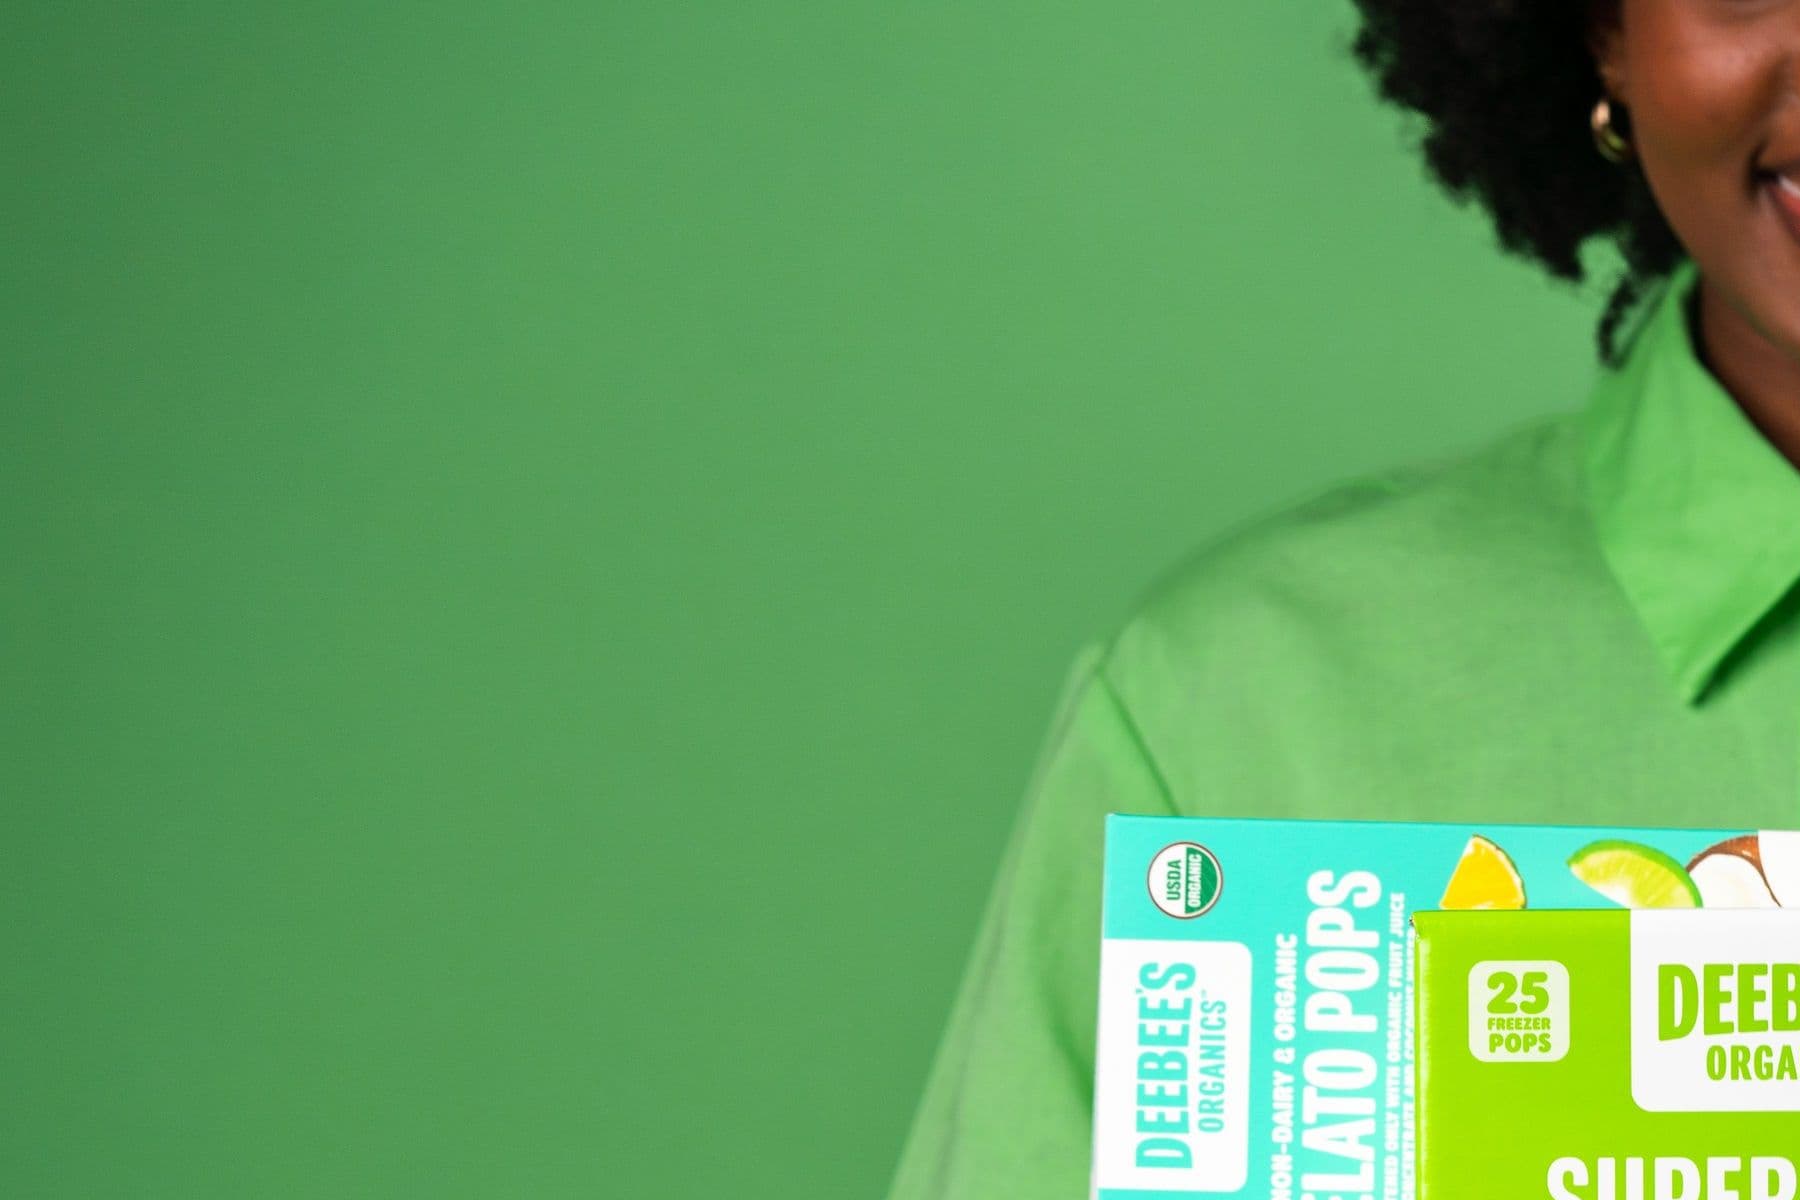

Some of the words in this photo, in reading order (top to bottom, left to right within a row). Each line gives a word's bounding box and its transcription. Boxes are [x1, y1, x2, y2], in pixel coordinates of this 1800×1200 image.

[1166, 859, 1182, 901] USDA
[1187, 853, 1201, 908] ORGANIC
[1389, 893, 1405, 938] JUICE
[1305, 870, 1382, 1033] POPS
[1388, 941, 1403, 987] FRUIT
[1273, 934, 1297, 1041] ORGANIC
[1486, 972, 1549, 1015] 25
[1386, 991, 1401, 1062] ORGANIC
[1487, 1017, 1551, 1031] FREEZER
[1488, 1033, 1551, 1053] POPS
[1135, 962, 1196, 1169] DEEBEE'S
[1198, 1000, 1227, 1133] ORGANICS
[1275, 1046, 1294, 1064] &
[1385, 1066, 1400, 1108] WITH
[1385, 1112, 1399, 1151] ONLY
